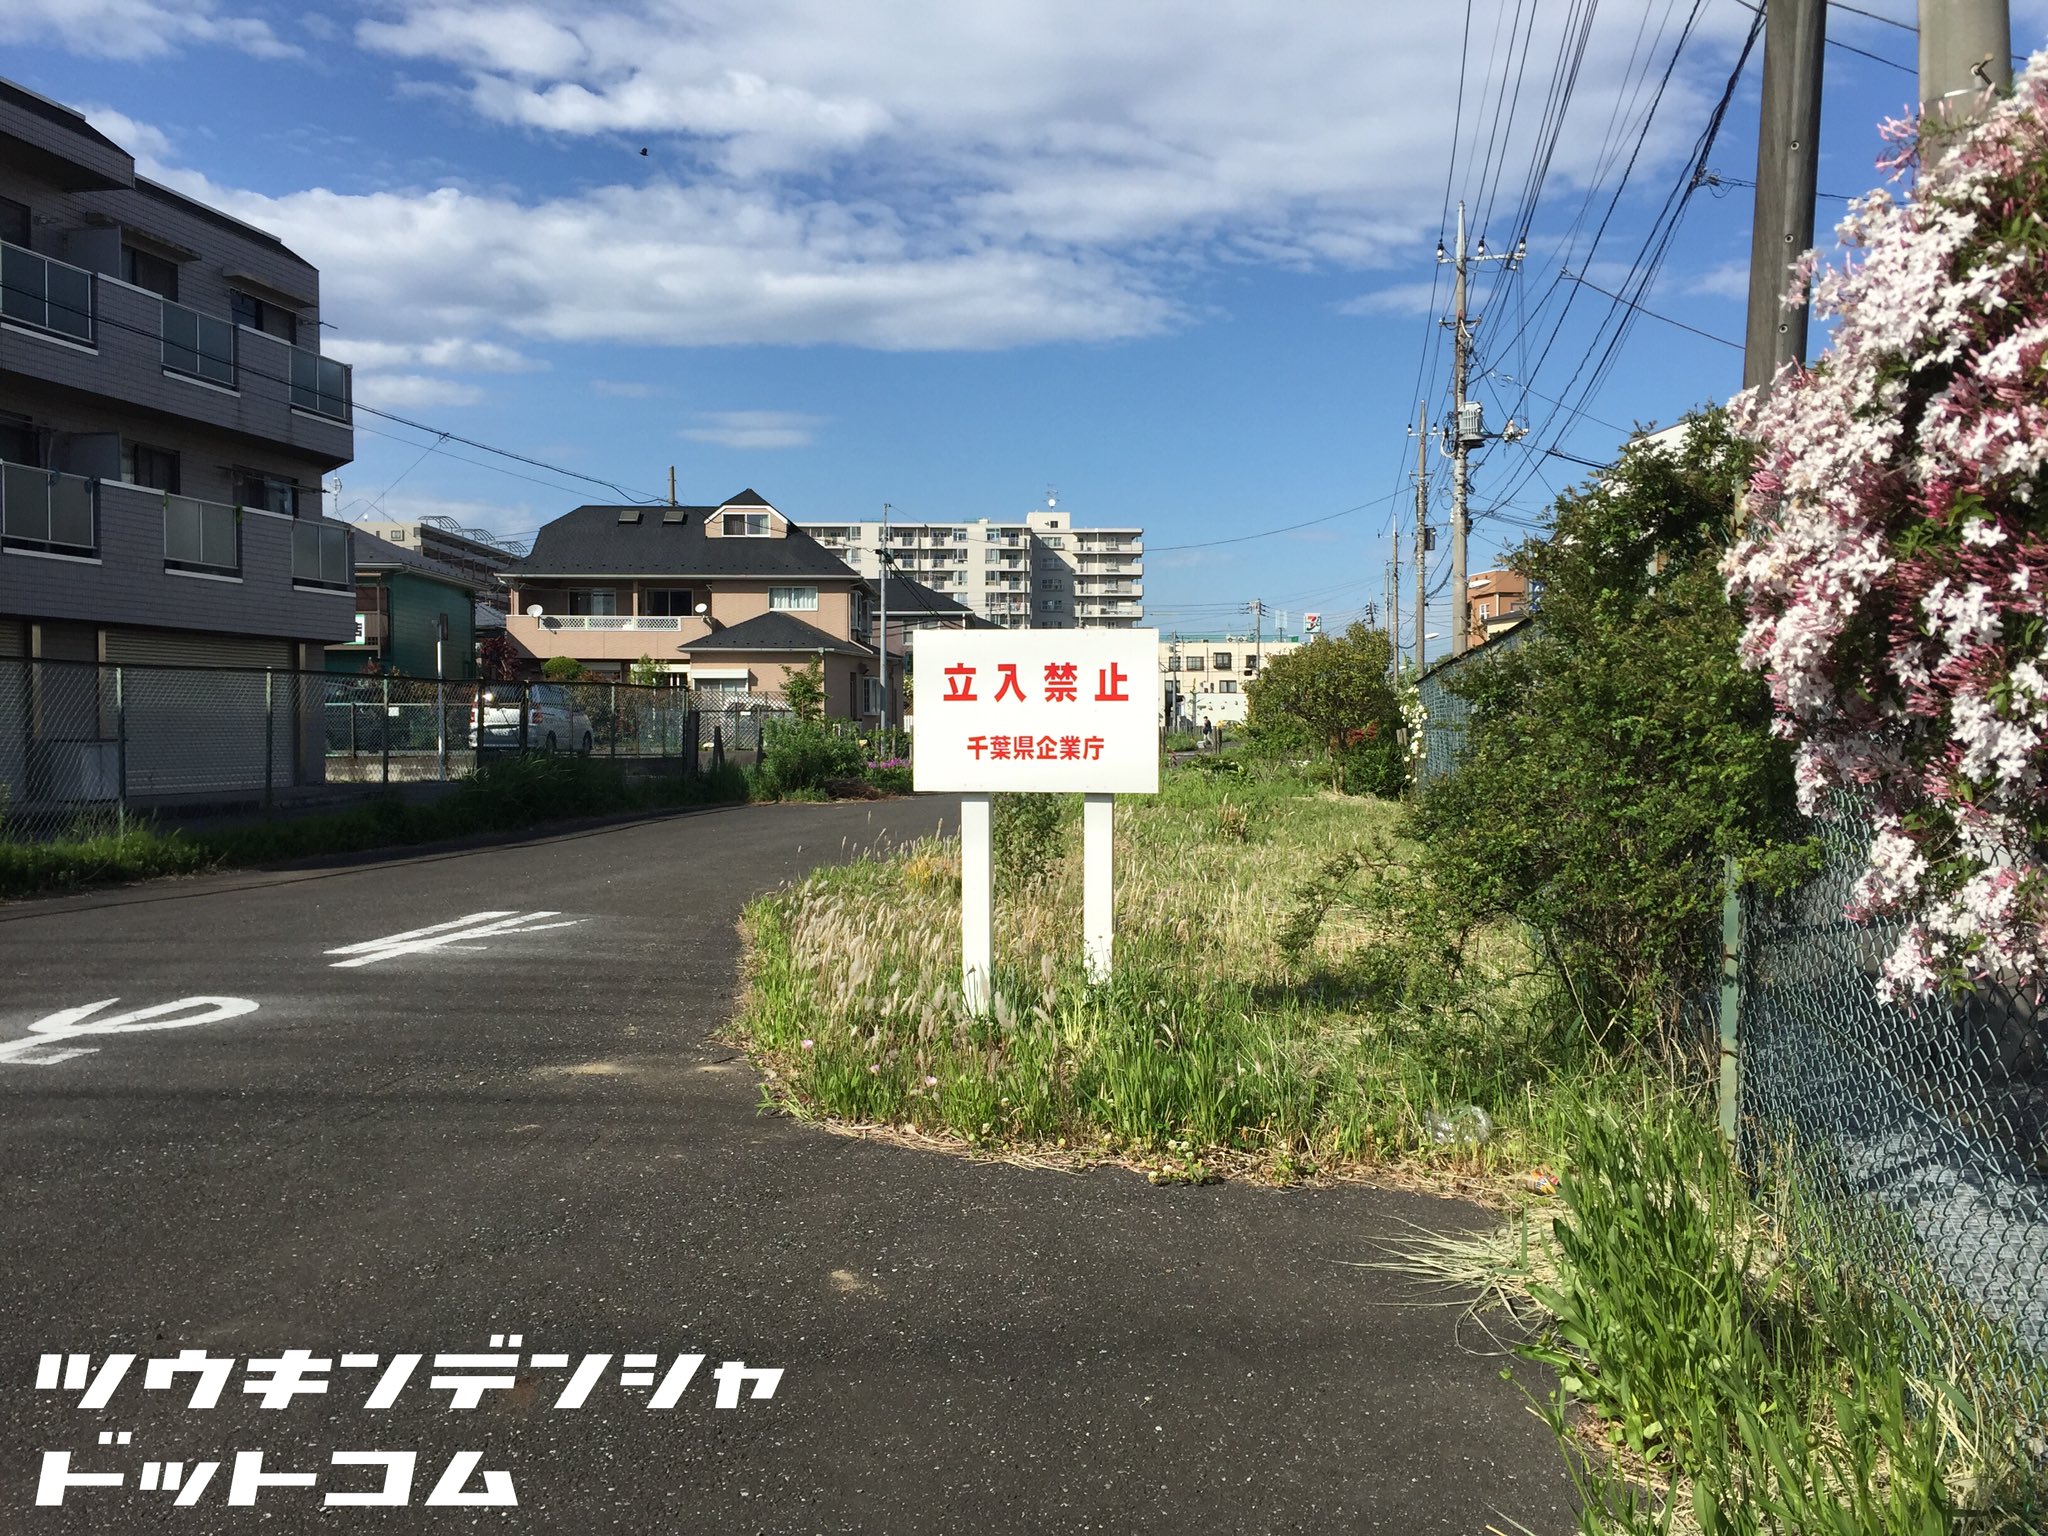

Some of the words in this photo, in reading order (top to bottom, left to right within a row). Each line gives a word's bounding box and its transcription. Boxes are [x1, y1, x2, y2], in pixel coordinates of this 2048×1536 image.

[944, 662, 1128, 702] 立入禁止
[968, 736, 1104, 760] 千葉県企業庁
